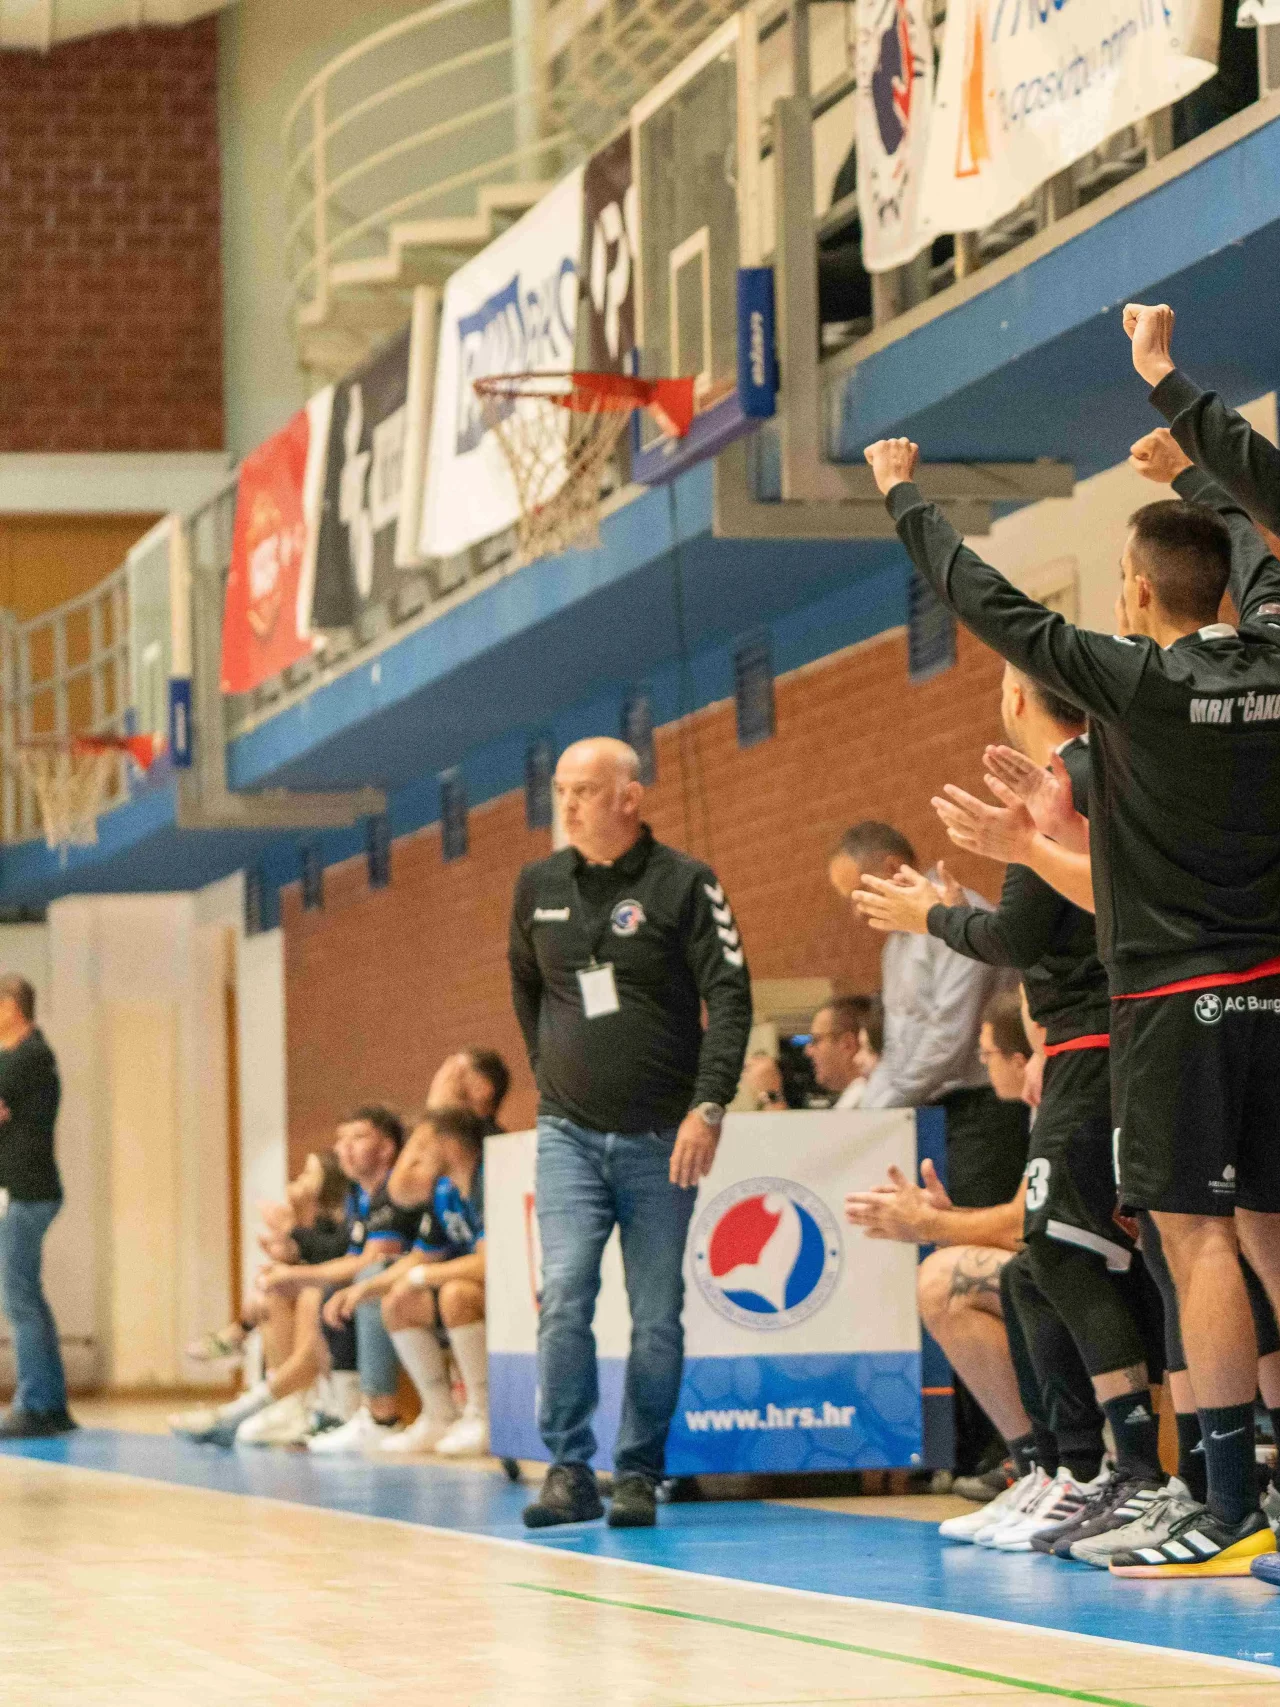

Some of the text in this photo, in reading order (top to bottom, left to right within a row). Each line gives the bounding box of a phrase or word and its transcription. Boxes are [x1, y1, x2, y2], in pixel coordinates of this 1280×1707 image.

[1190, 698, 1235, 722] MRK
[1224, 996, 1246, 1011] AC
[684, 1400, 857, 1432] www.hrs.hr
